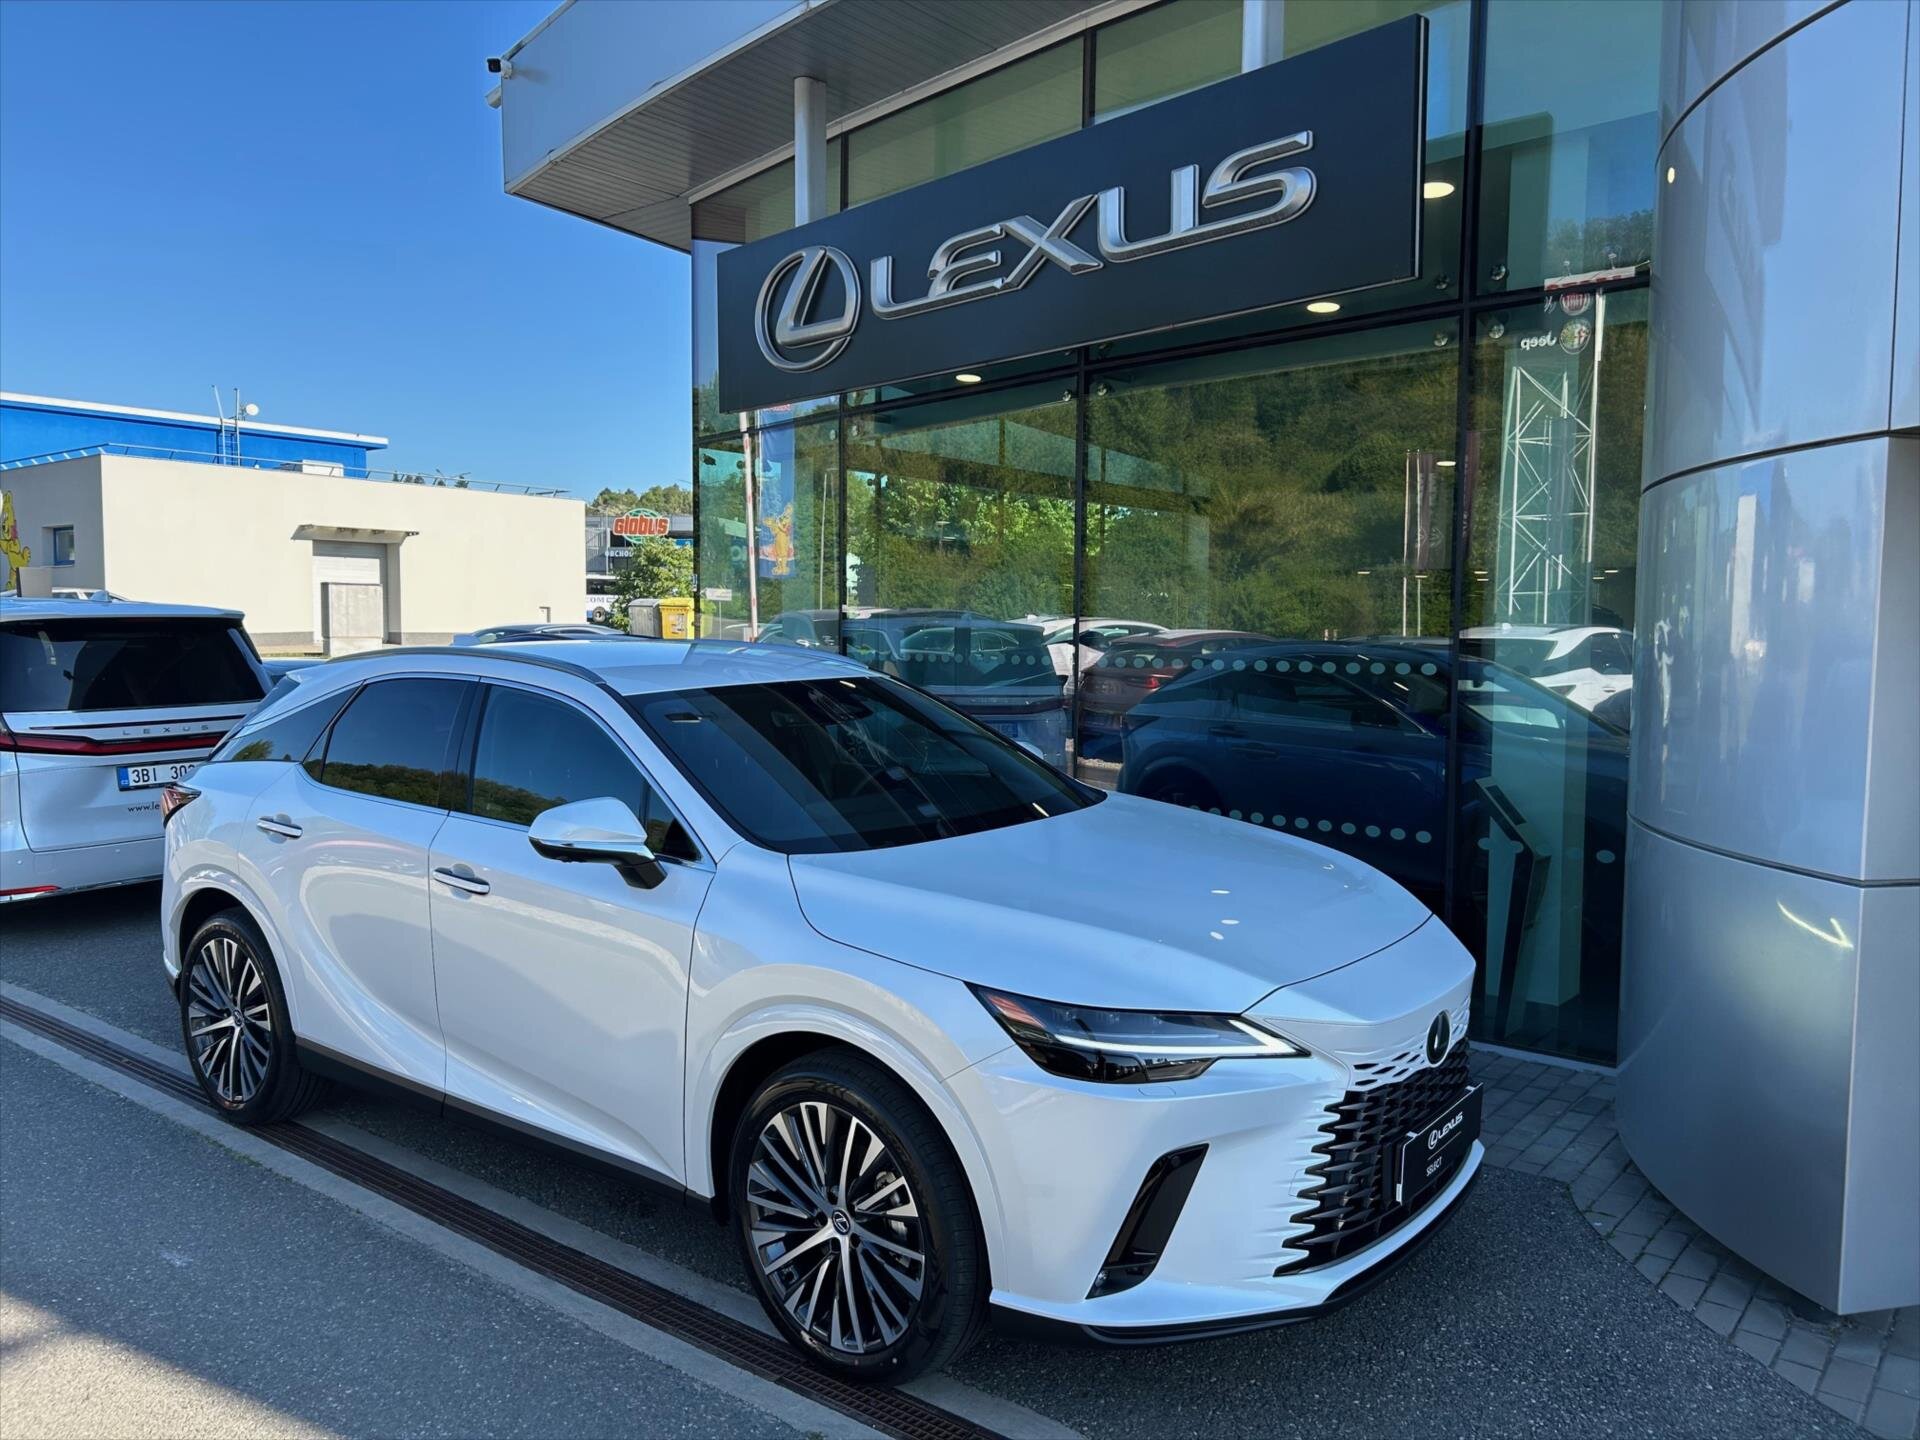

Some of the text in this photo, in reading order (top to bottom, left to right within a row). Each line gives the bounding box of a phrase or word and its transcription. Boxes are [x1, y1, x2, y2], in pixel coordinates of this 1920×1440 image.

[870, 130, 1317, 319] LEXUS
[122, 724, 209, 736] LEXUS
[131, 767, 157, 784] 3BI
[1438, 1111, 1463, 1139] LEXUS
[1426, 1156, 1442, 1177] SELECT
